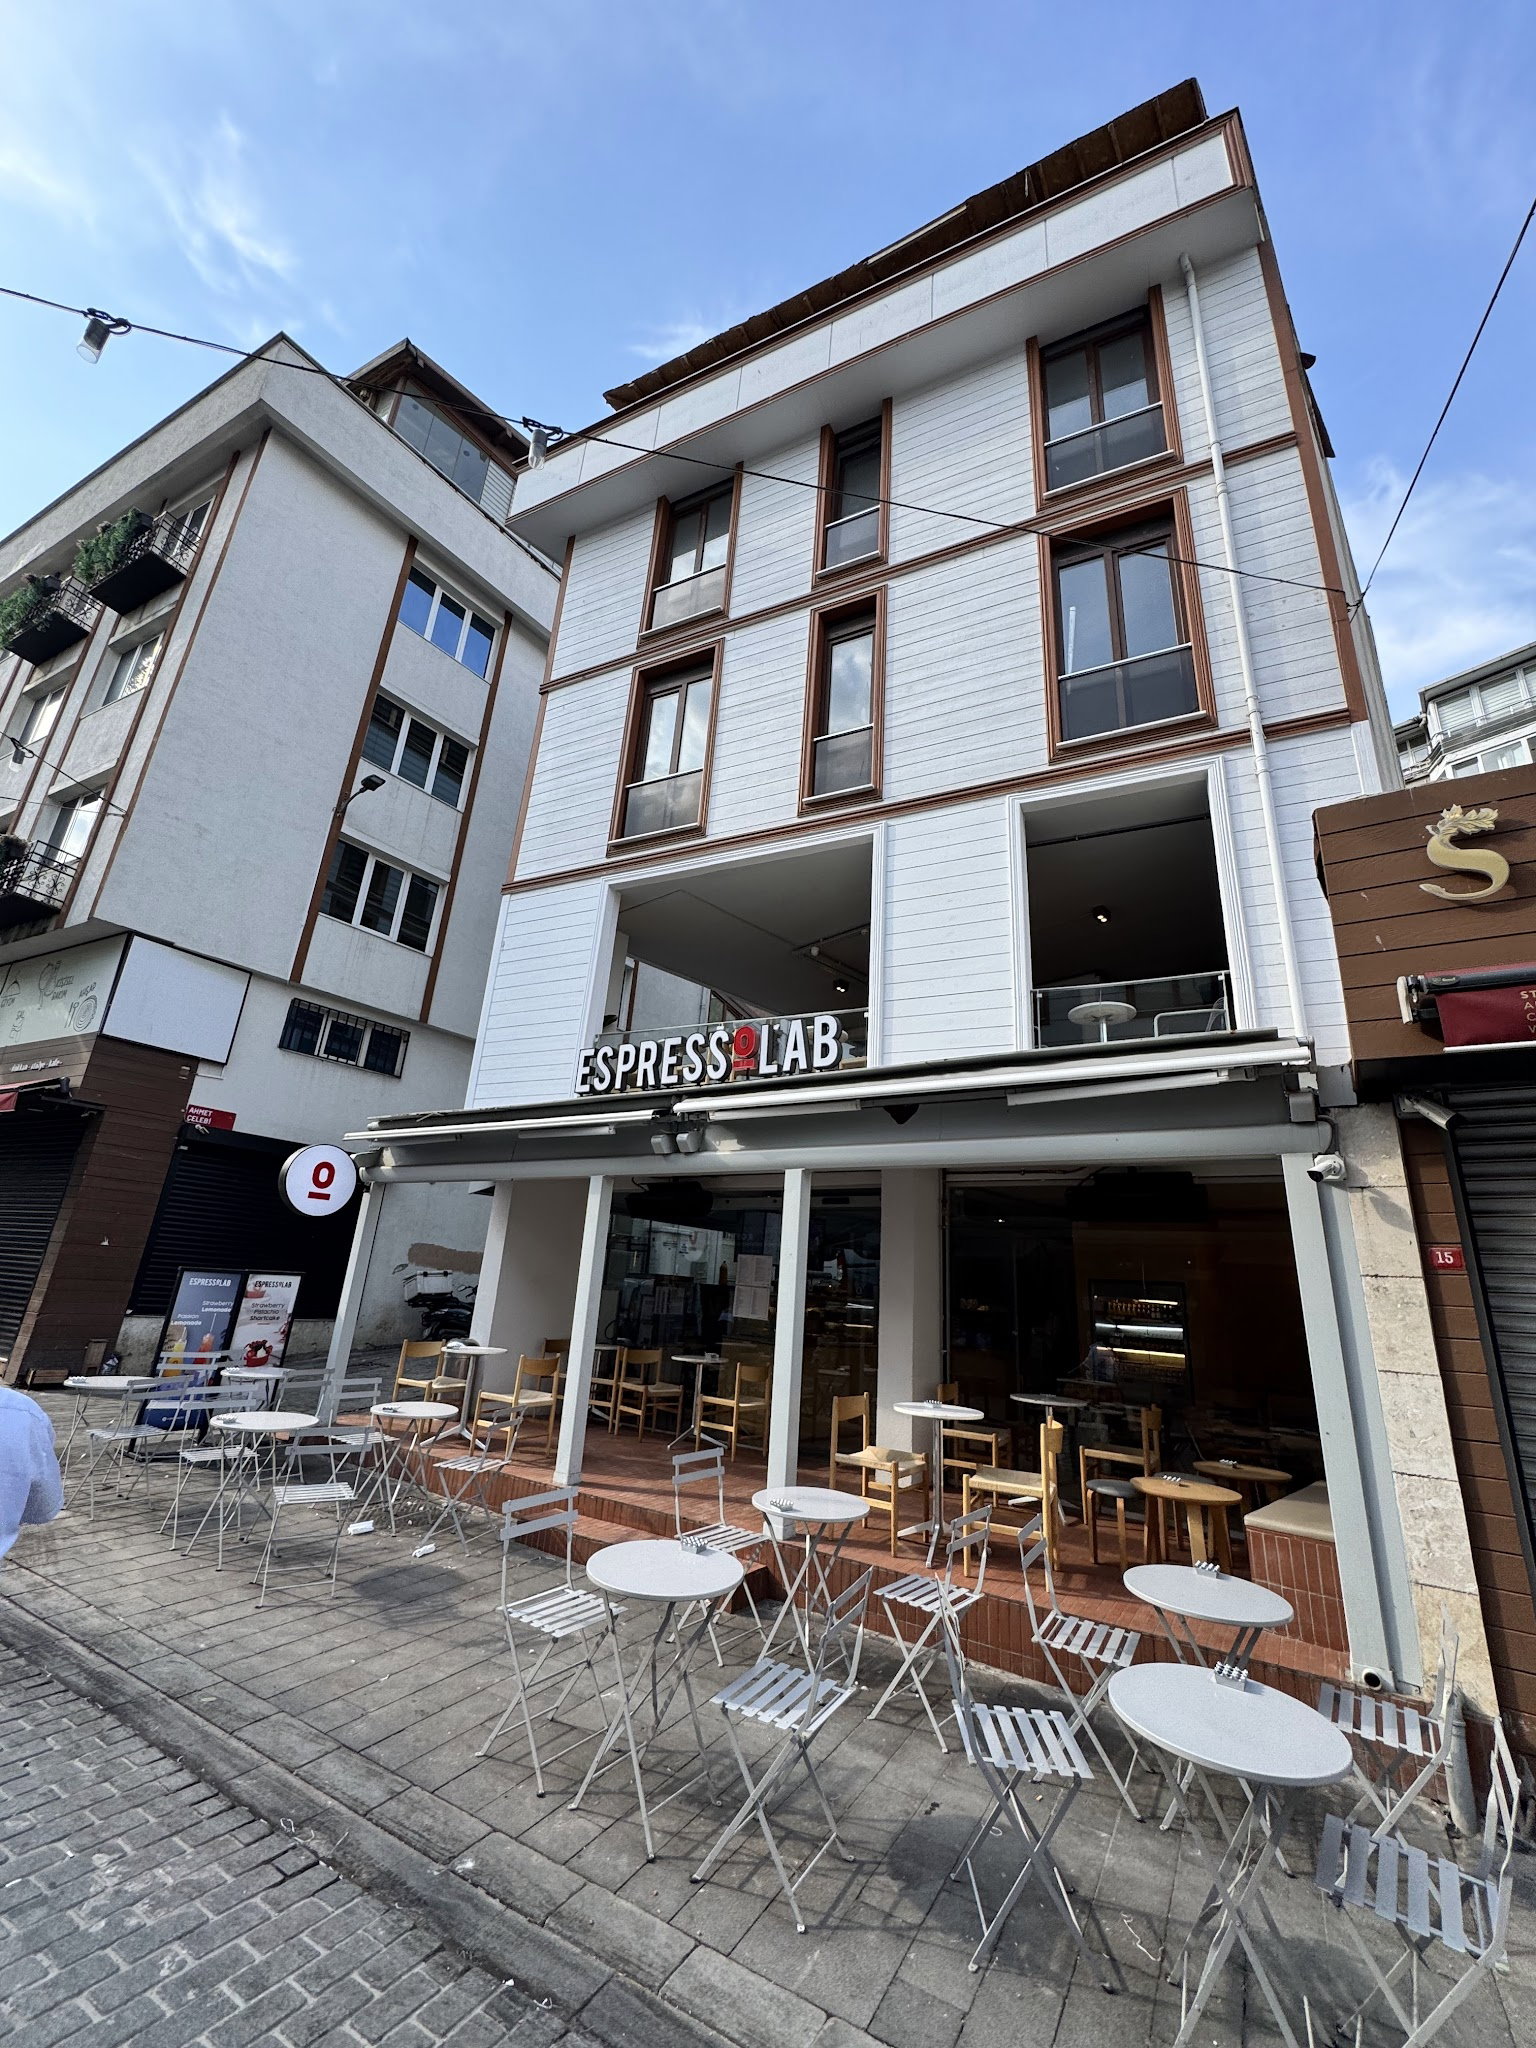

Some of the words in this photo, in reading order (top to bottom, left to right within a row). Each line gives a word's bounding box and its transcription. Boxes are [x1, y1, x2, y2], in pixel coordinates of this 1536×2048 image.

[575, 1015, 842, 1094] ESPRESSOLAB
[189, 1106, 213, 1117] AHMET
[1436, 1251, 1454, 1264] 15
[202, 1300, 234, 1308] Strawberry
